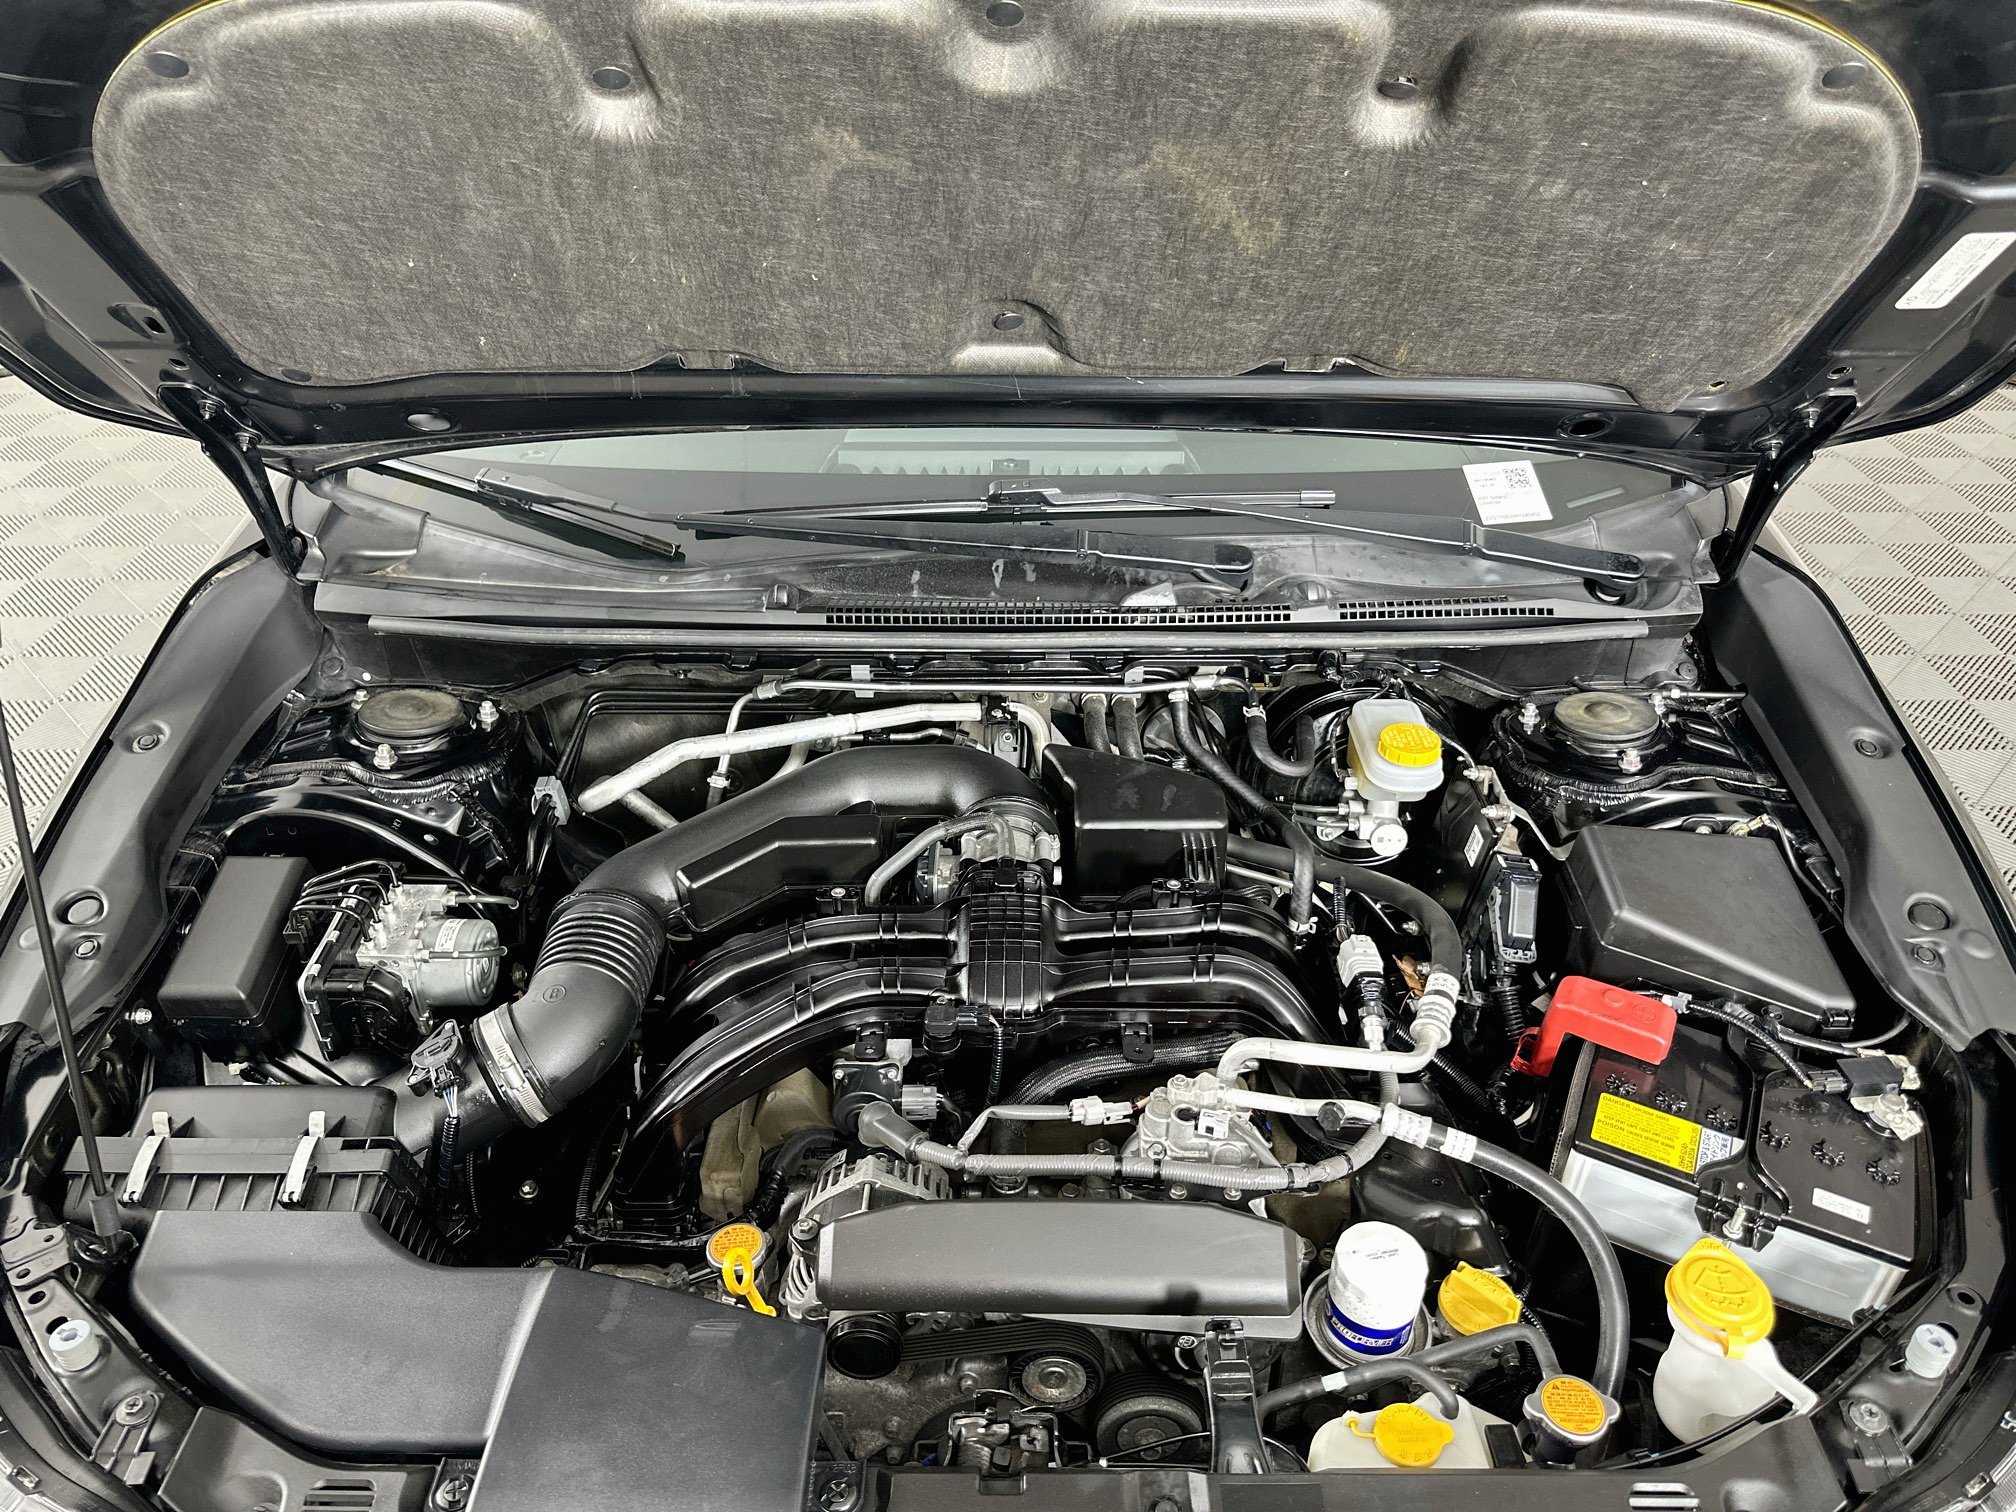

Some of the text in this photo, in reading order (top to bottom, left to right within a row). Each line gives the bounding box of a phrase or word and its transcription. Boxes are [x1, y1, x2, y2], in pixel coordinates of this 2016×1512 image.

[1602, 1095, 1631, 1109] DANGER
[1597, 1118, 1625, 1132] POISON
[1330, 1315, 1394, 1346] PROFORMER
